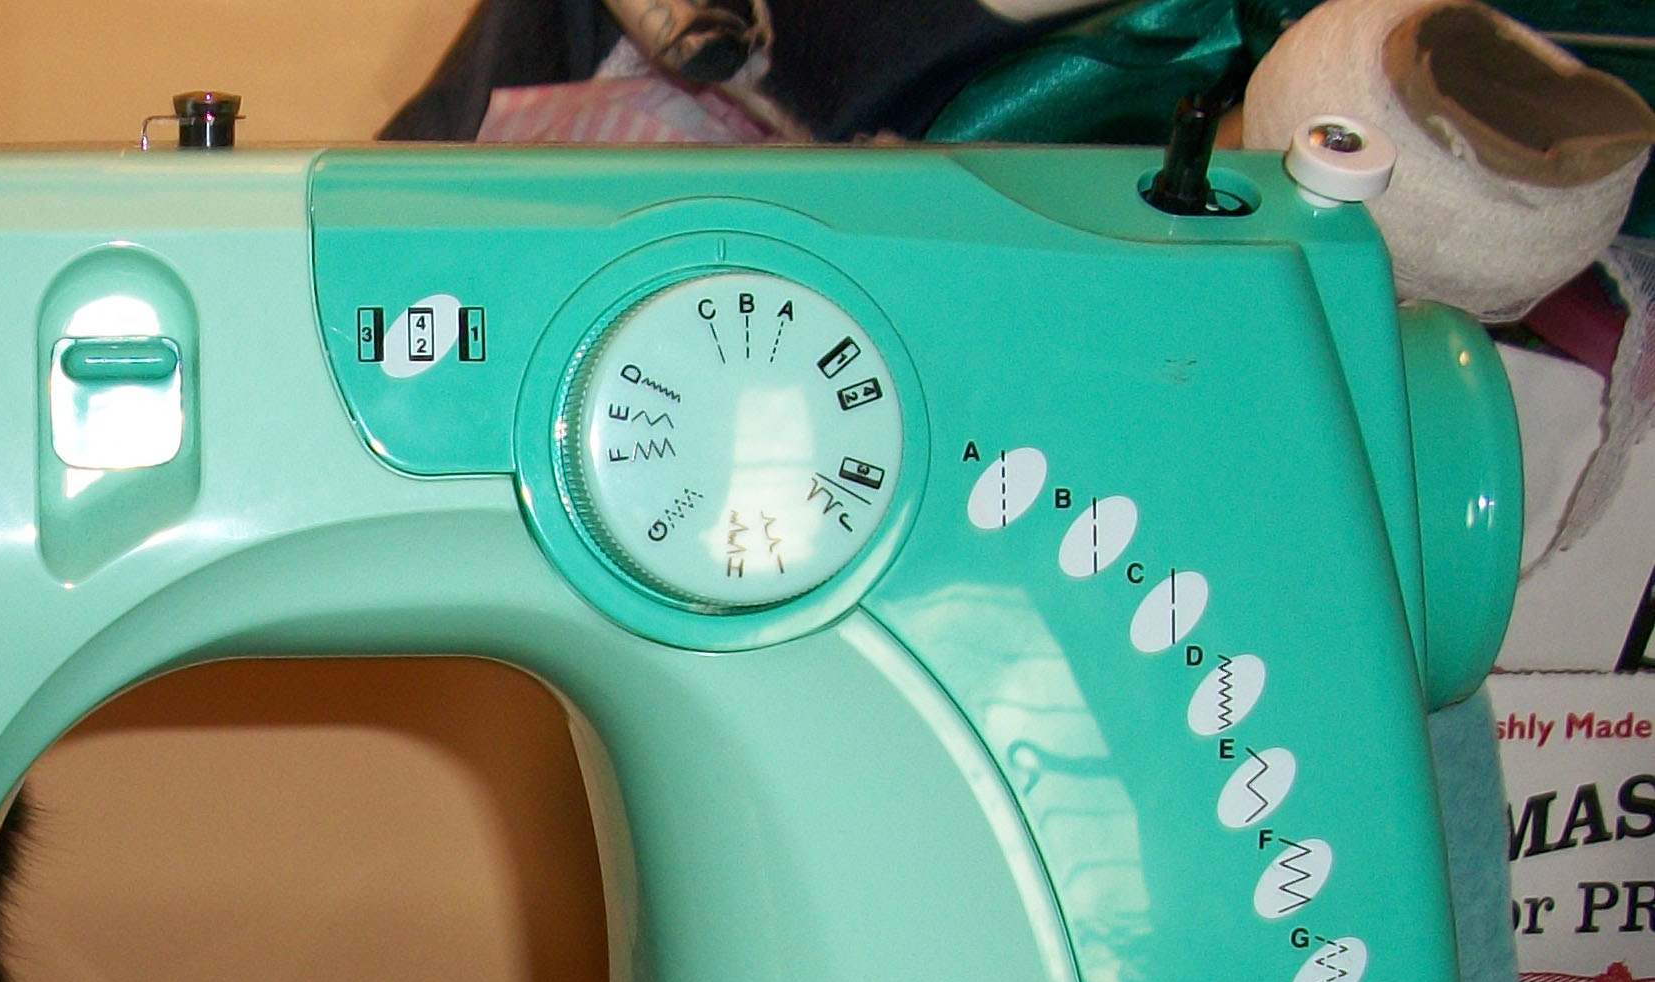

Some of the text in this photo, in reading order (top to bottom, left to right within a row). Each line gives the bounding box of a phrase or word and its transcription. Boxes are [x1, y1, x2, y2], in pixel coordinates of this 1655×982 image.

[698, 298, 716, 320] C
[739, 293, 755, 314] B
[777, 300, 795, 322] A
[416, 315, 426, 330] 4
[361, 326, 373, 342] 3
[470, 326, 479, 342] 1
[416, 338, 427, 353] 2
[620, 364, 643, 384] D
[608, 403, 630, 421] E
[608, 448, 630, 462] F
[962, 441, 981, 462] A
[1055, 488, 1072, 509] B
[648, 520, 668, 542] G
[727, 557, 744, 578] H
[1127, 562, 1144, 583] C
[1186, 646, 1203, 666] D
[1565, 712, 1653, 740] Made
[1219, 739, 1235, 759] E
[1259, 829, 1274, 850] F
[1290, 928, 1310, 949] G
